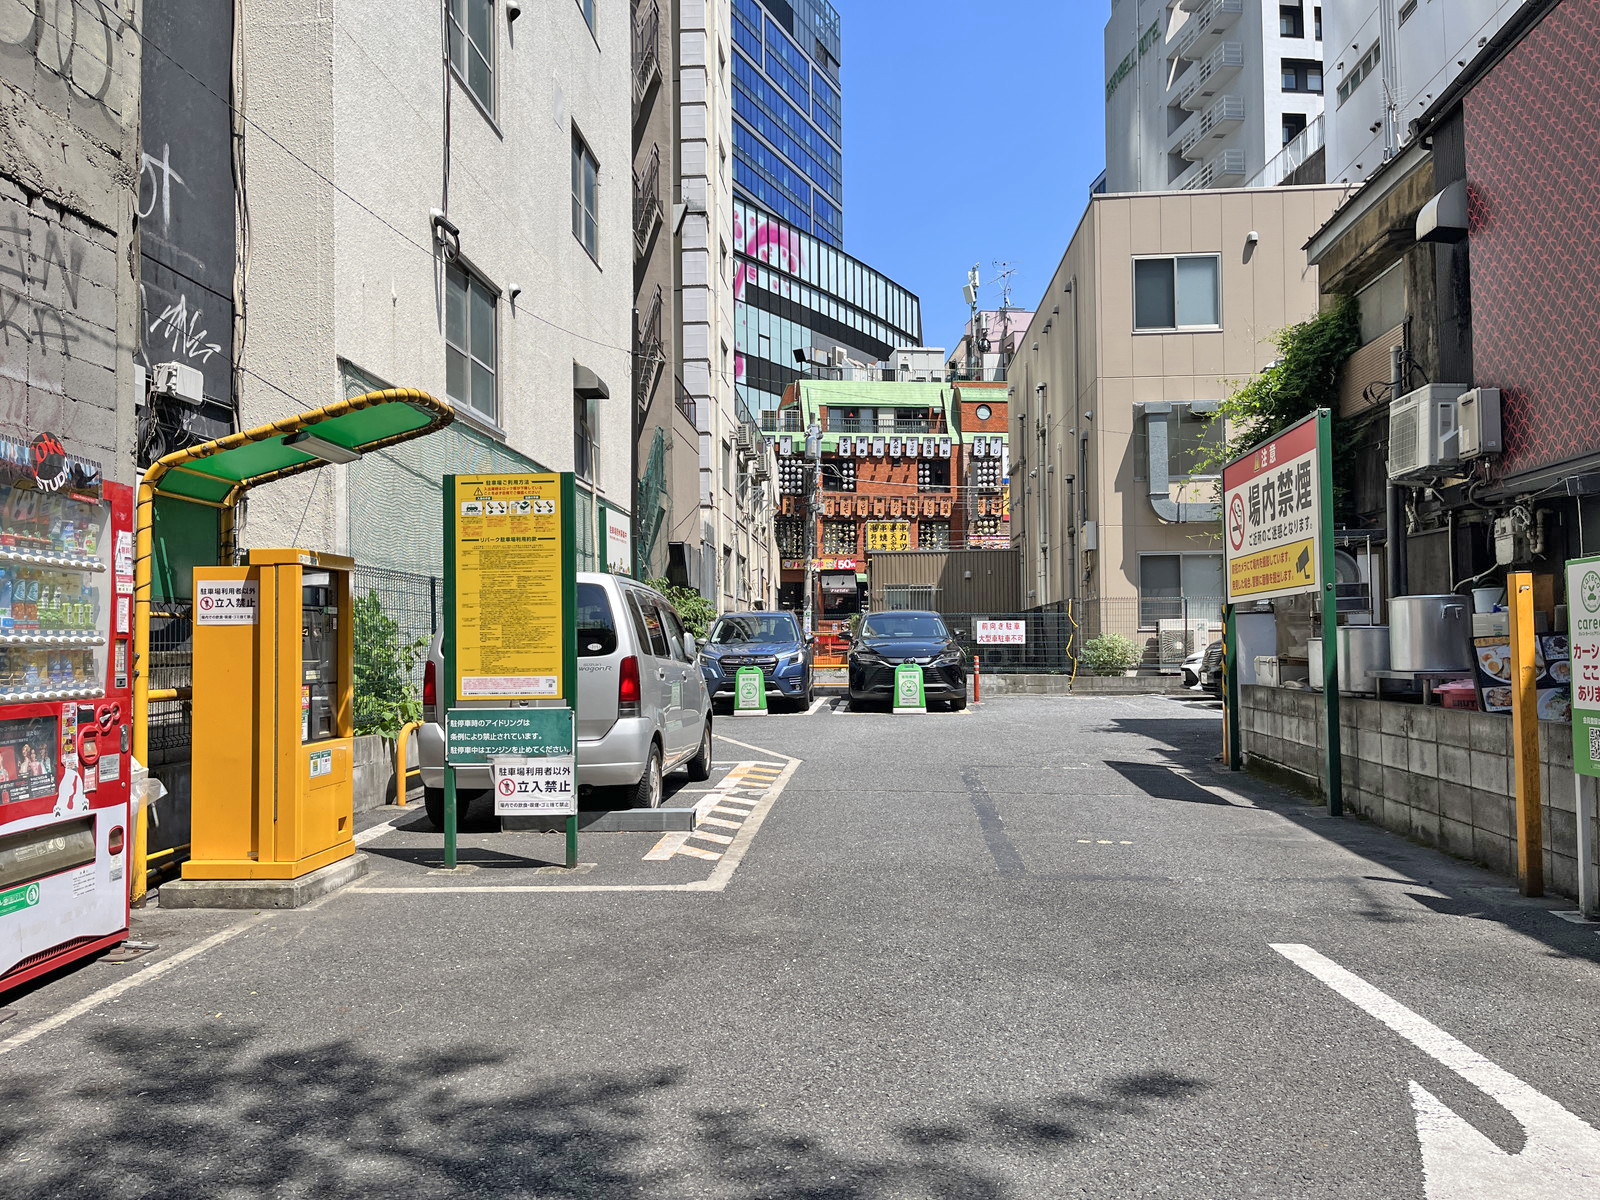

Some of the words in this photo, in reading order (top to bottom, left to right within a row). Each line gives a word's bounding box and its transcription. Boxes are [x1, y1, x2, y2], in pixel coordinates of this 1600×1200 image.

[1261, 443, 1277, 467] 注意
[36, 456, 70, 492] STUDIO
[1249, 460, 1312, 527] 場内禁煙
[1249, 516, 1312, 546] ご近所のご迷惑となります。
[200, 587, 256, 595] 駐車場利用者以外
[215, 598, 256, 608] 立入禁止
[981, 622, 1021, 631] 前向き駐車
[1578, 618, 1600, 630] care
[978, 634, 1024, 643] 大型車駐車不可
[450, 719, 531, 728] 駐停車時のアイドリングは
[450, 732, 543, 741] 条例により禁止されています。
[450, 746, 570, 754] 駐停車中はエンジンを止めてください。
[498, 766, 571, 777] 駐車場利用者以外
[517, 780, 572, 793] 立入禁止
